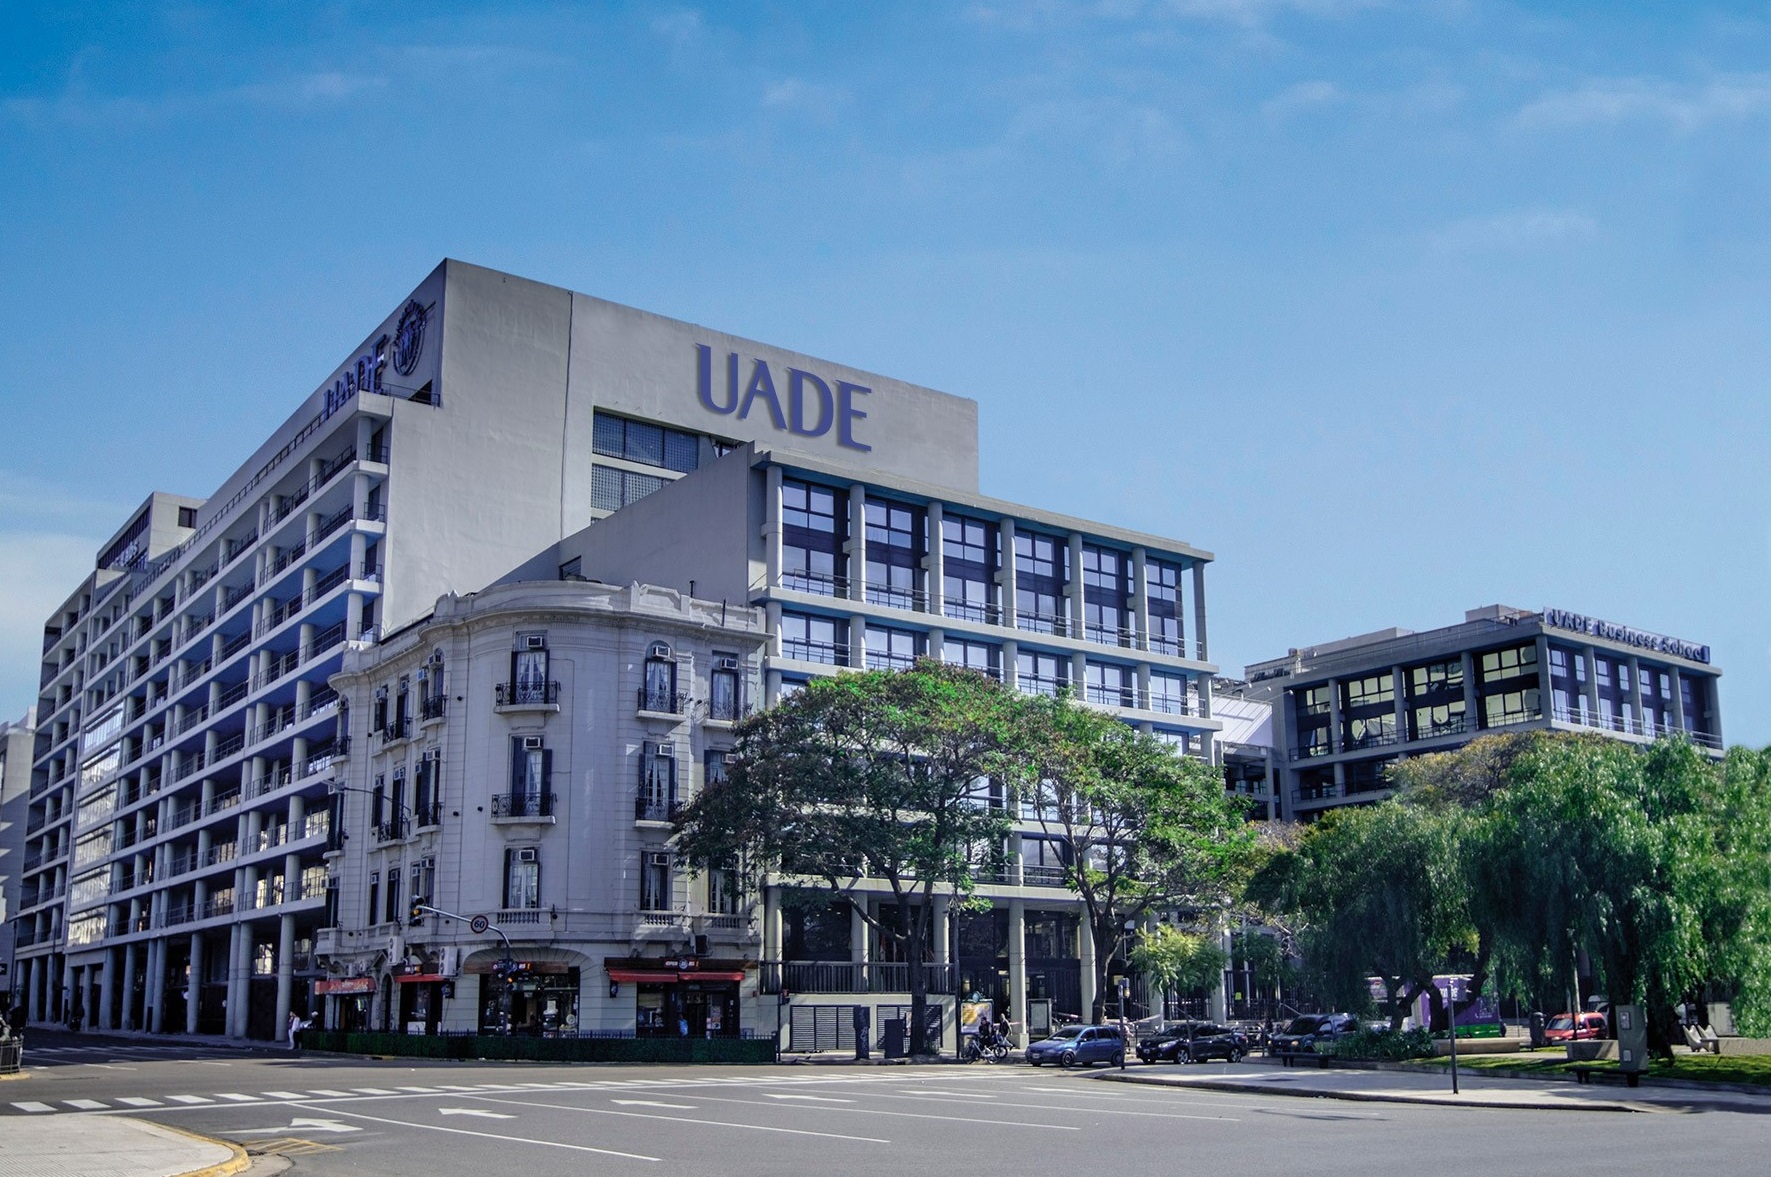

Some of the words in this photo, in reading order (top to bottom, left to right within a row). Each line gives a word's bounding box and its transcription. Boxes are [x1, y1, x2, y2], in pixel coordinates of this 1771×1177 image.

[695, 342, 872, 452] UADE
[1549, 608, 1593, 636] UADE
[1596, 619, 1659, 650] Business
[1661, 636, 1710, 664] School
[474, 920, 485, 929] 60
